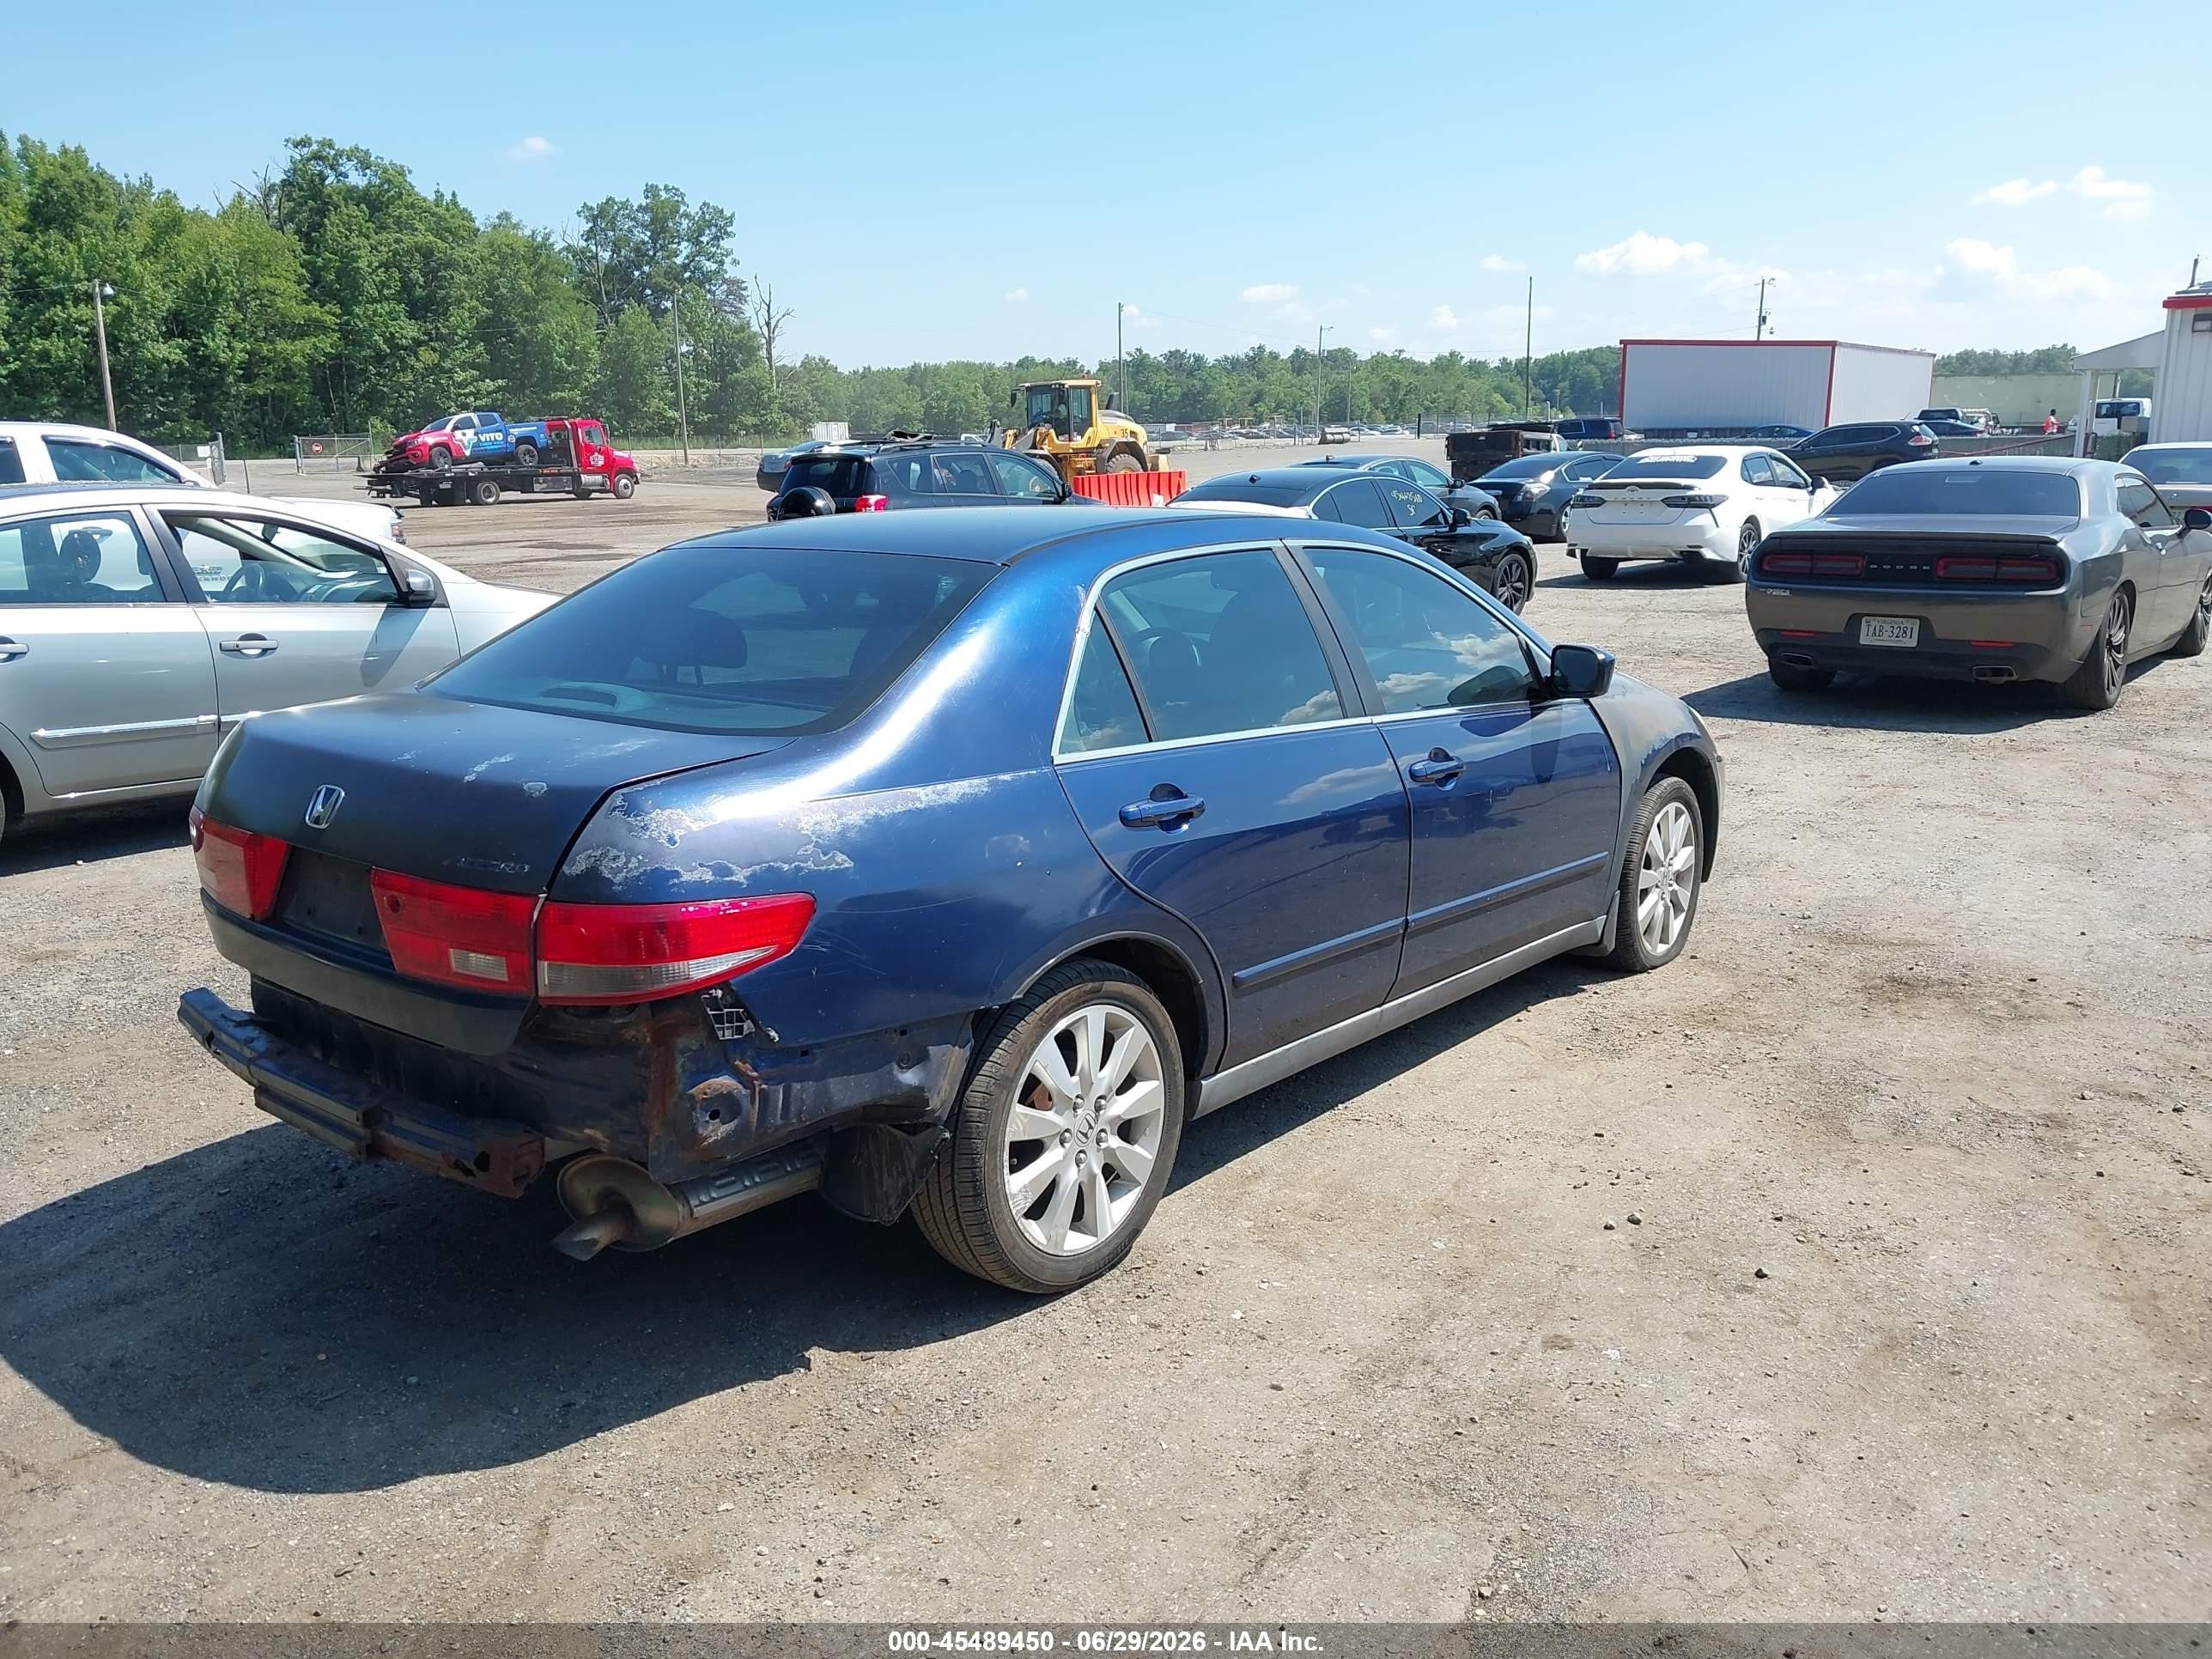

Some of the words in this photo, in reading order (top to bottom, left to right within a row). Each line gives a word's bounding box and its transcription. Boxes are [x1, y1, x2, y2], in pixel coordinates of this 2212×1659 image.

[478, 432, 503, 442] VITO
[1121, 428, 1128, 438] 35
[1866, 624, 1914, 639] TAB-3281
